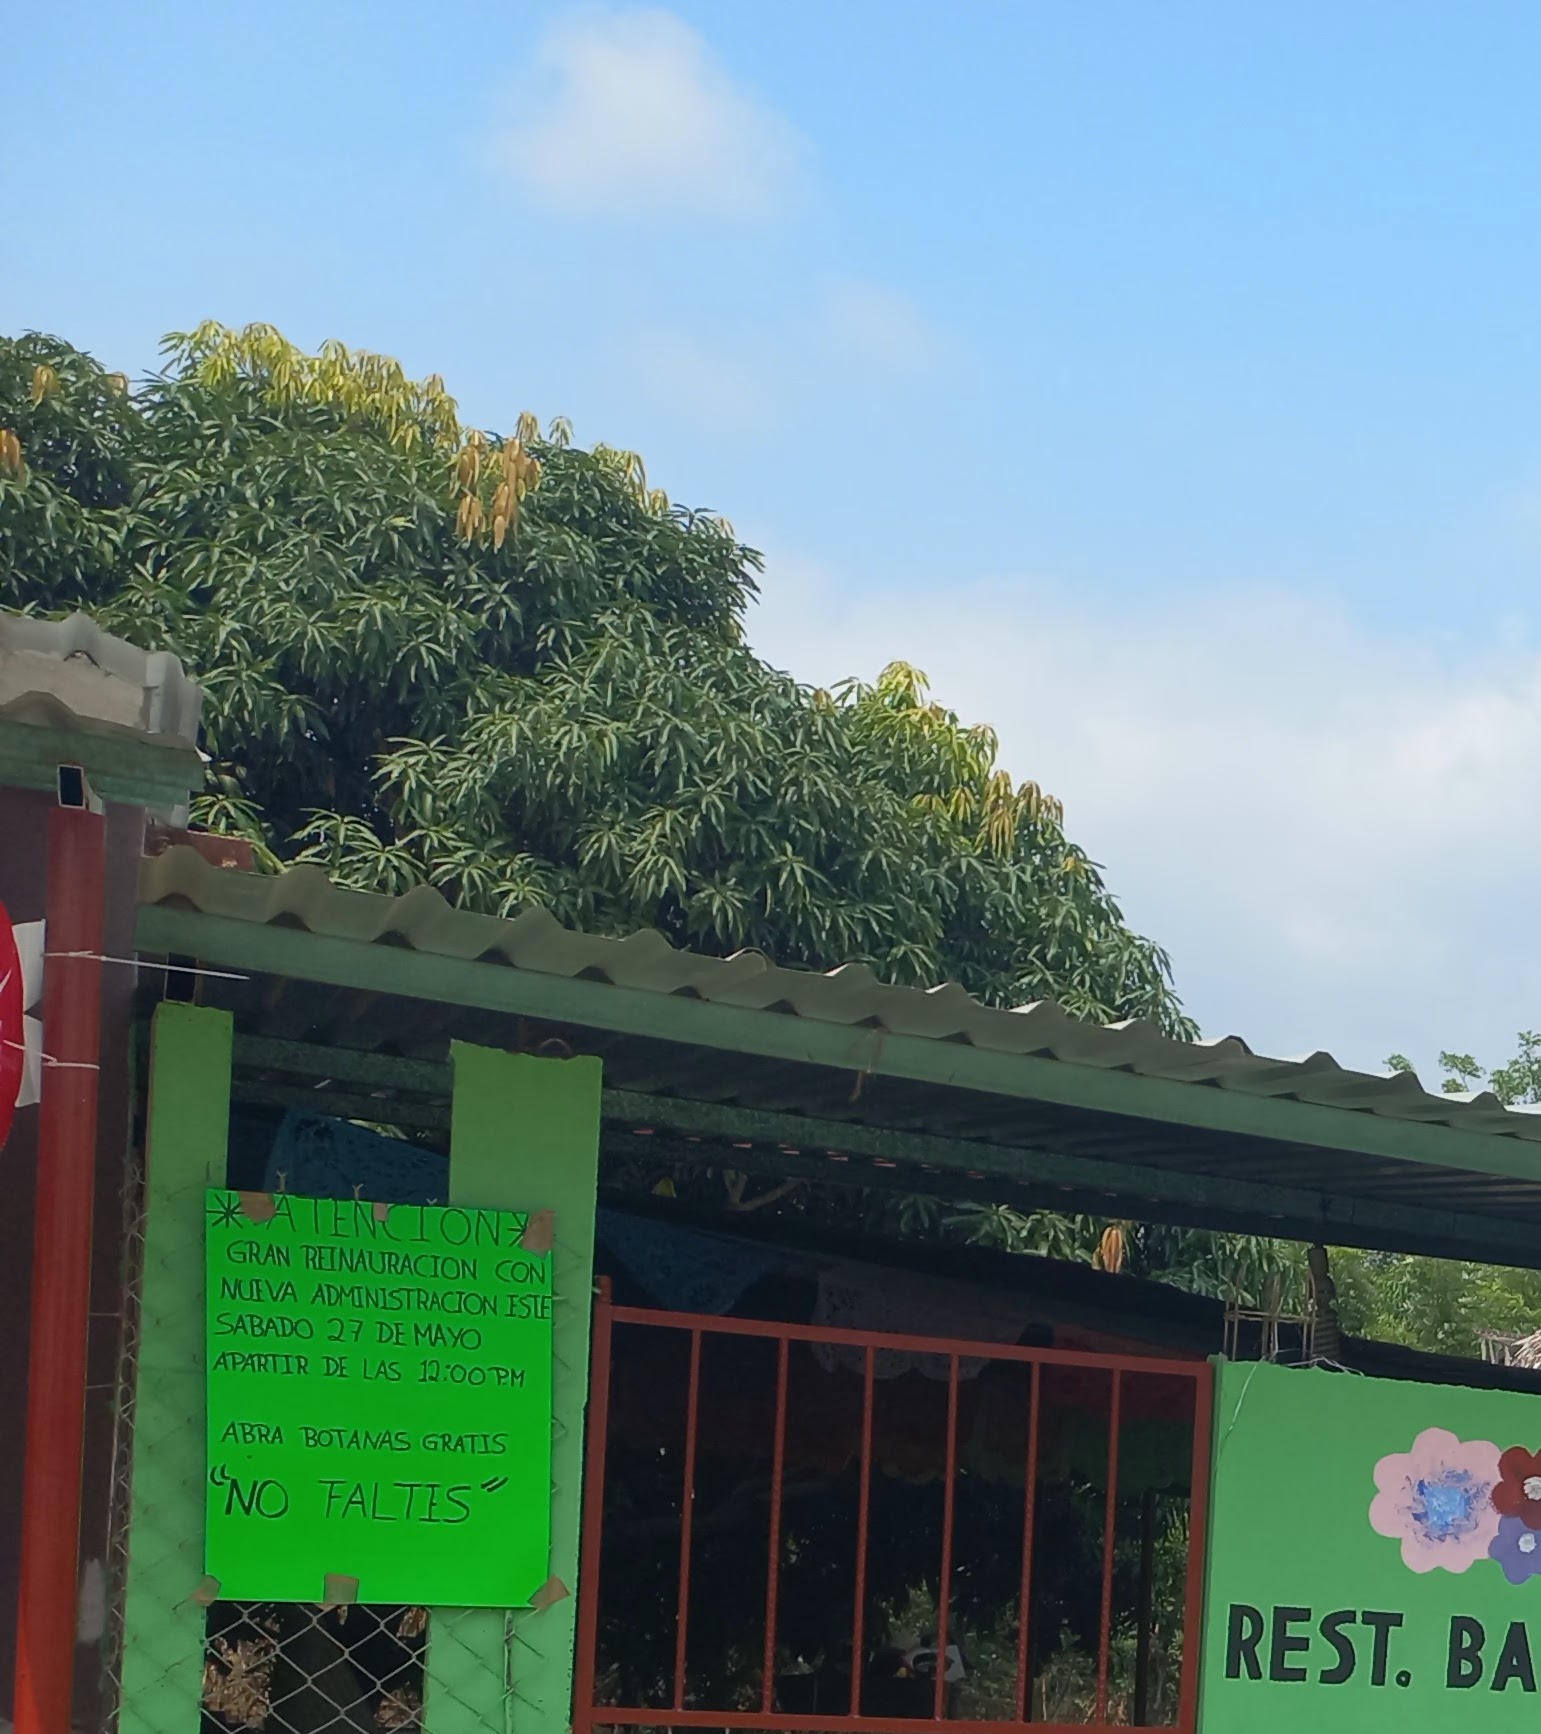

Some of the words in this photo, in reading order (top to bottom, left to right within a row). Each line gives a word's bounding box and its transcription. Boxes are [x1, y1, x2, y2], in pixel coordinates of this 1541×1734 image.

[226, 1240, 291, 1267] GRAN
[495, 1259, 546, 1285] CON
[220, 1277, 298, 1303] NUEVA
[310, 1283, 498, 1316] ADMINISTRACION
[504, 1294, 552, 1320] ESTE
[213, 1312, 315, 1340] SABADO
[327, 1317, 364, 1342] 27
[376, 1321, 407, 1346] DE
[414, 1322, 482, 1350] MAYO
[212, 1351, 309, 1375] APARTIR
[322, 1355, 349, 1378] DE
[363, 1358, 401, 1381] LAS
[417, 1359, 486, 1386] 12:00
[220, 1421, 284, 1445] ABRA
[298, 1426, 411, 1451] BOTANAS
[421, 1432, 509, 1455] GRATIS
[1224, 1603, 1411, 1689] REST.
